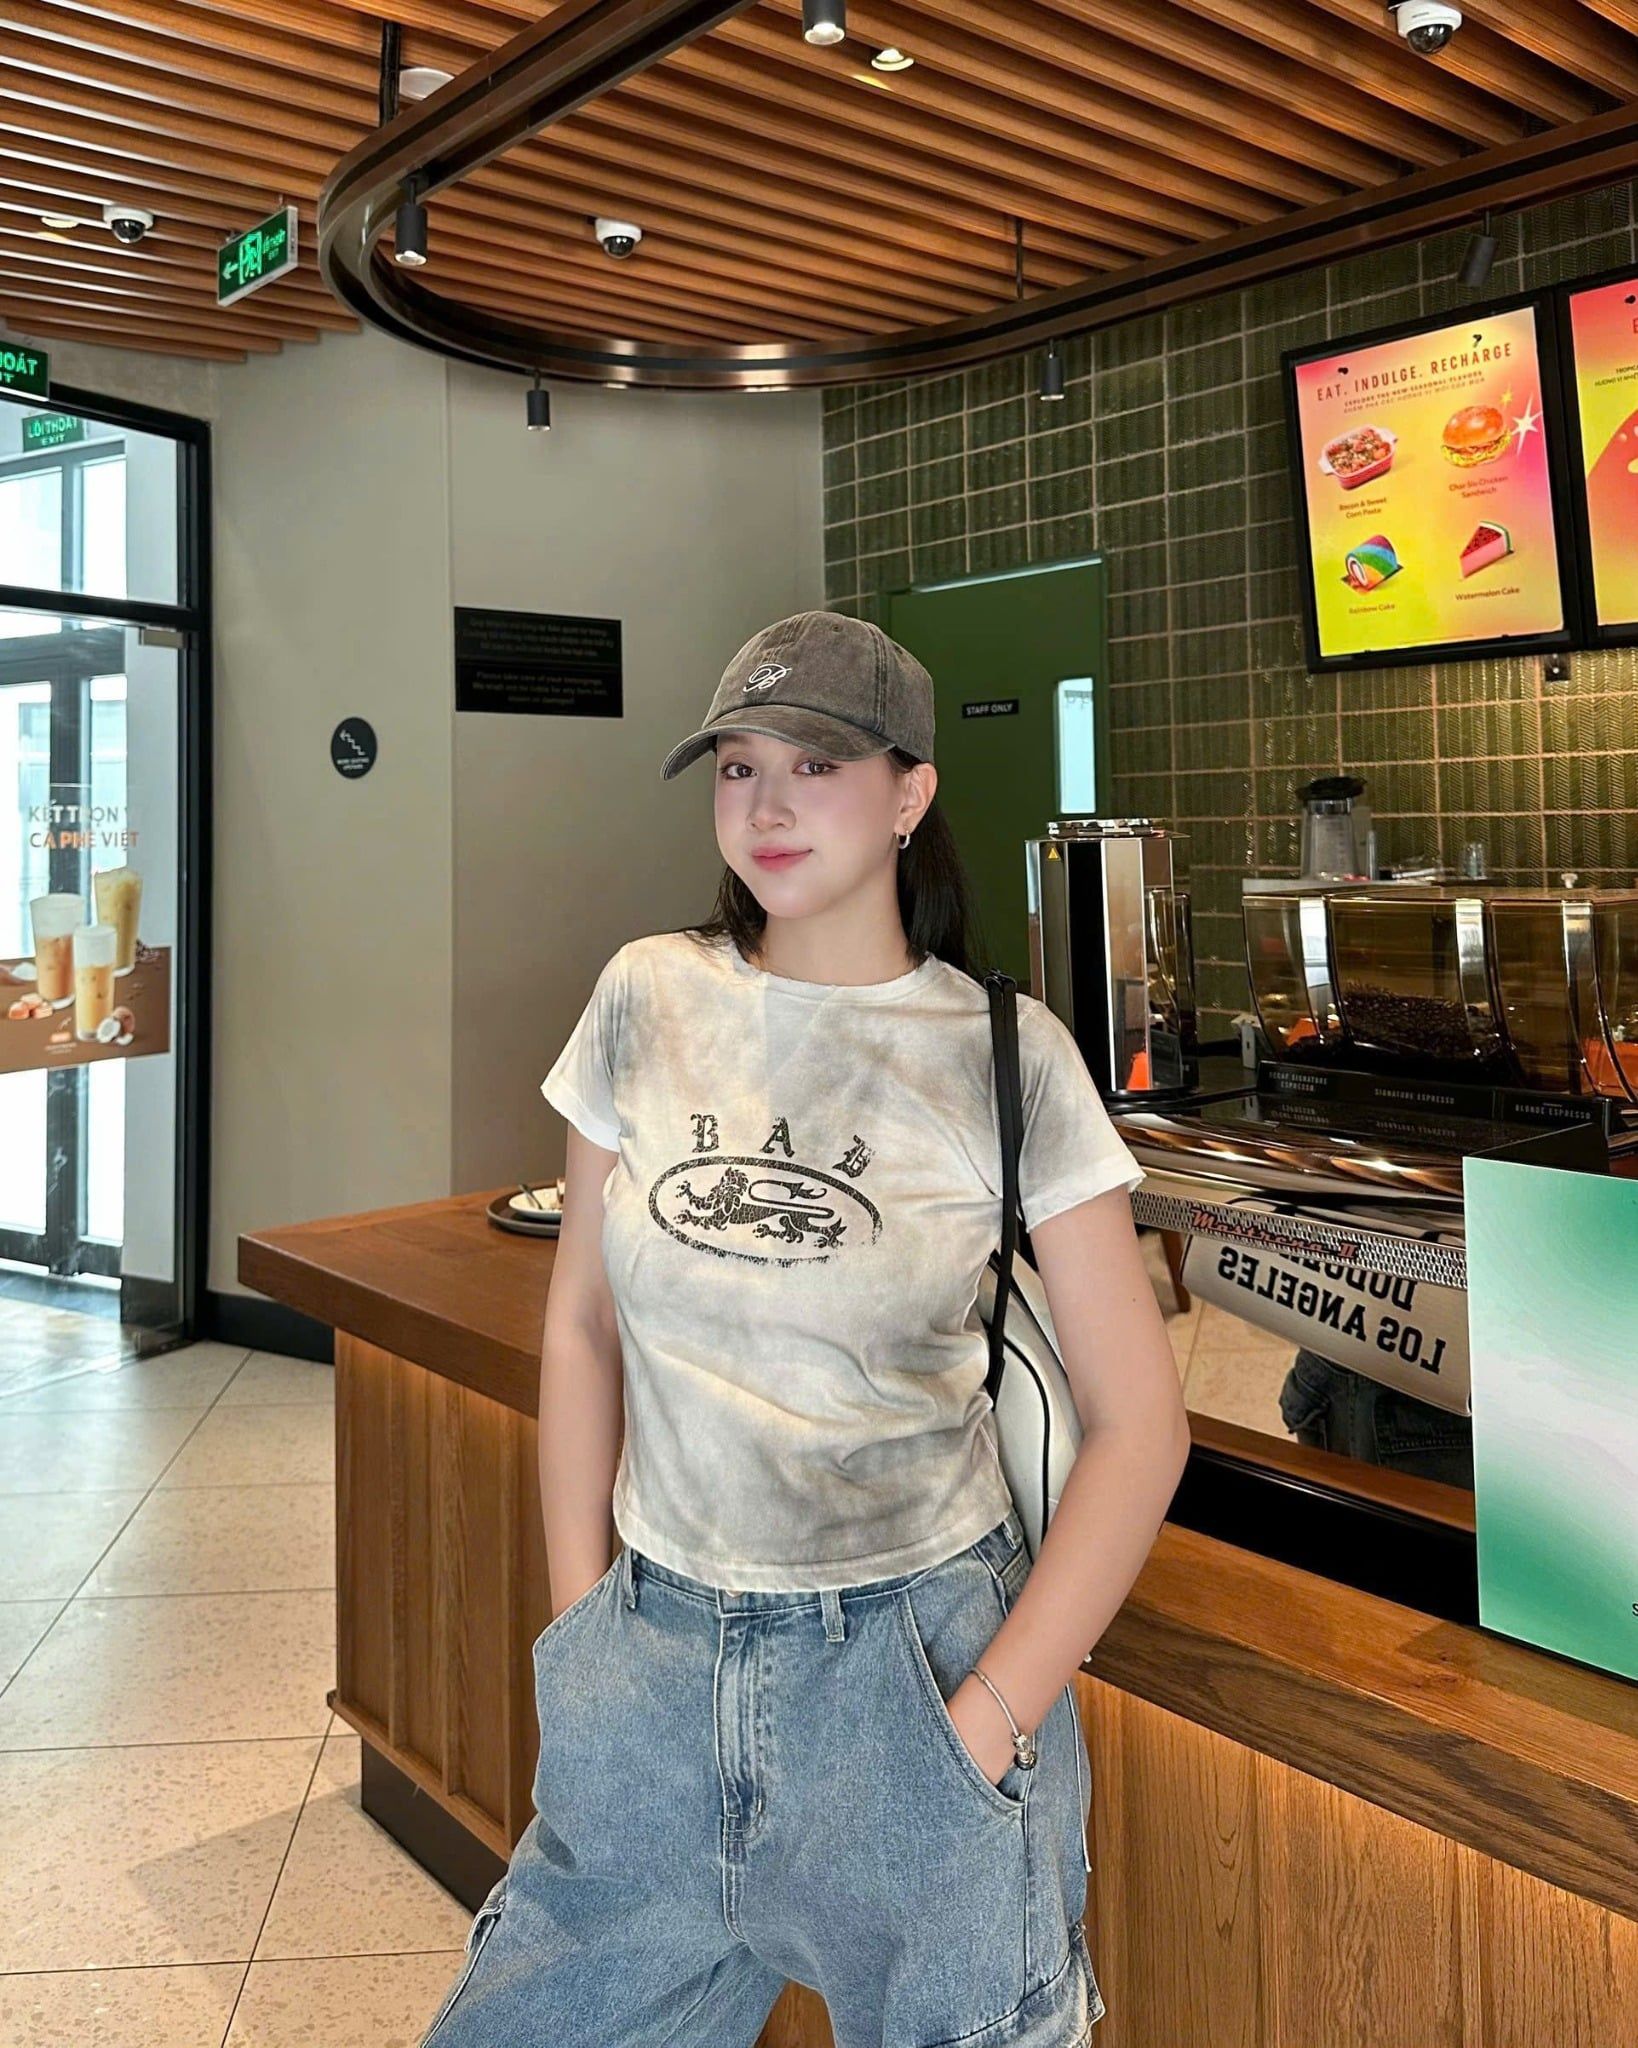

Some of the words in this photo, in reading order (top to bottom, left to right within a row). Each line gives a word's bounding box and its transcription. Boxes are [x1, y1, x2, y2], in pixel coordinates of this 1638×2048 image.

[1317, 384, 1348, 402] EAT.
[1354, 366, 1424, 393] INDULGE.
[1430, 343, 1512, 375] RECHARGE
[41, 433, 65, 446] EXIT
[1455, 588, 1501, 601] Watermelon
[1501, 586, 1520, 596] Cake
[1378, 602, 1395, 612] Cake
[966, 704, 990, 716] STAFF
[991, 703, 1013, 714] ONLY
[1280, 1080, 1315, 1092] ESPRESSO
[1374, 1088, 1414, 1100] SIGNATURE
[1417, 1092, 1456, 1105] ESPRESSO
[1515, 1103, 1545, 1115] BLONDE
[1548, 1107, 1591, 1120] ESPRESSO
[1190, 1209, 1326, 1254] Mastrena
